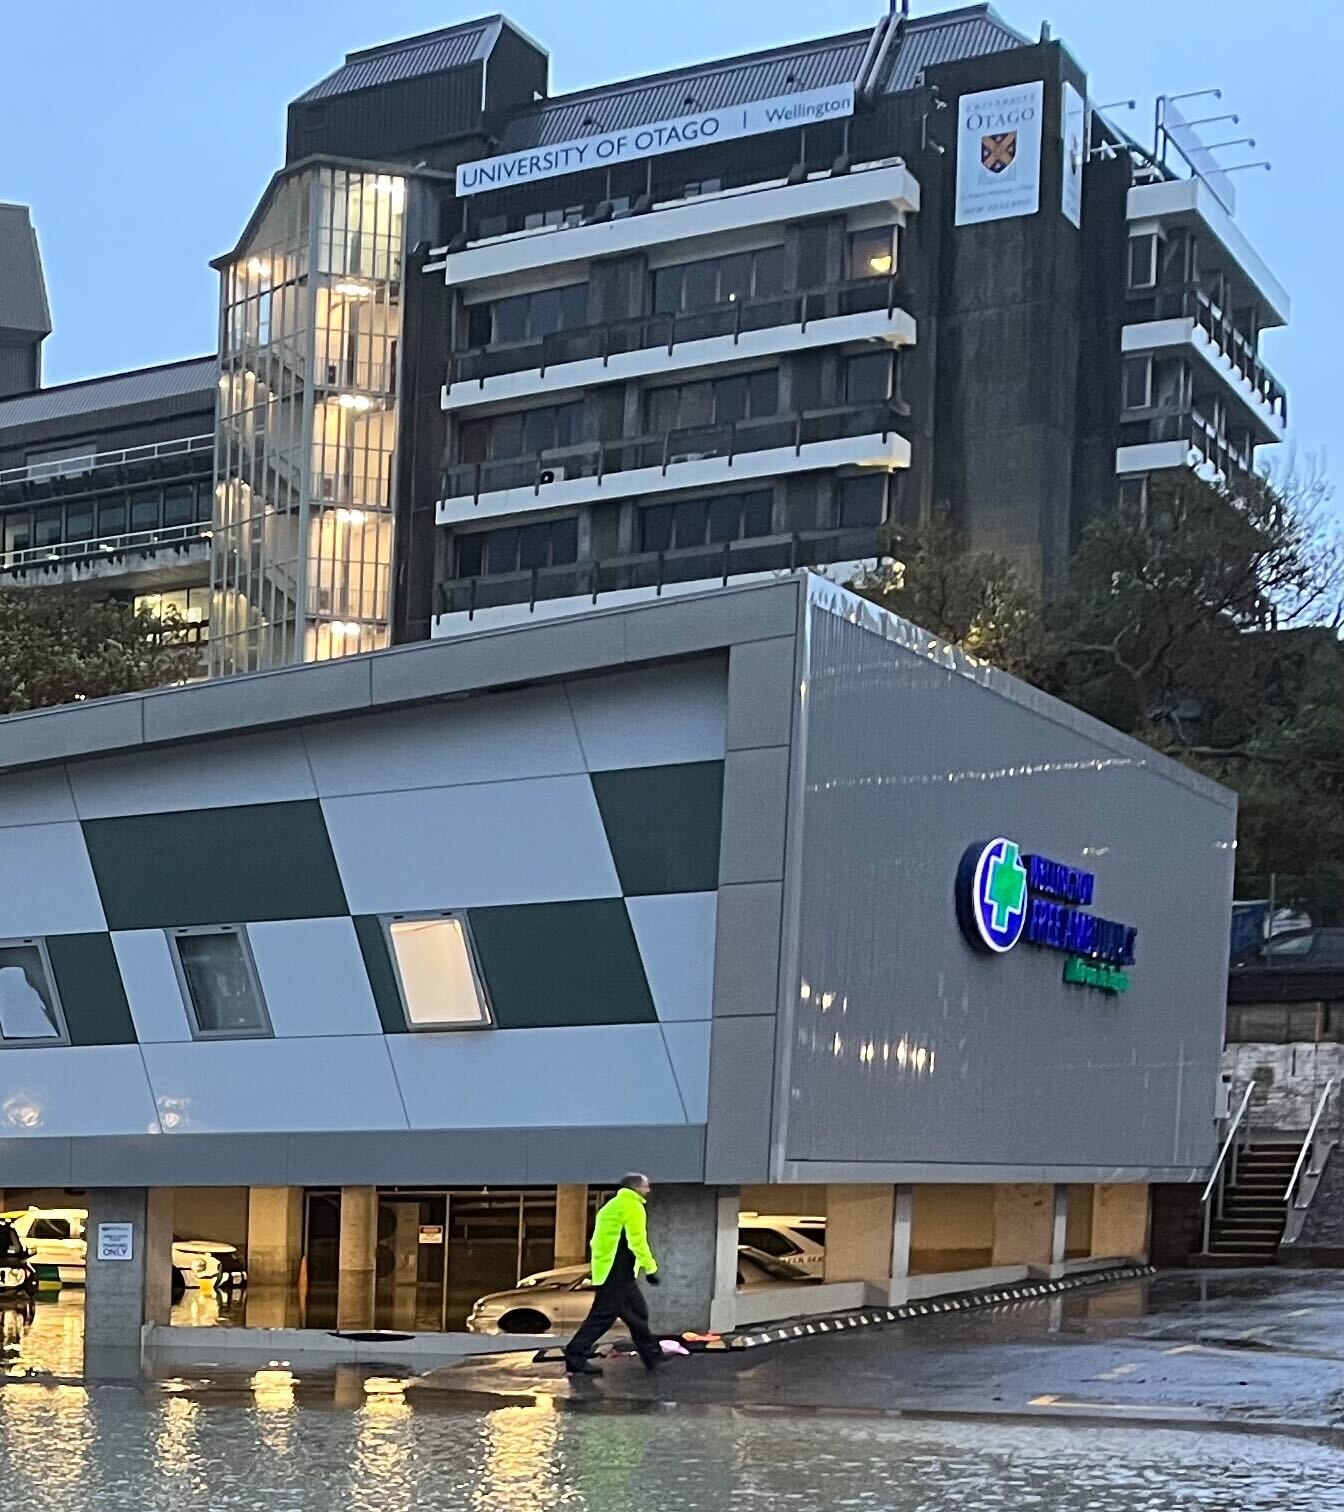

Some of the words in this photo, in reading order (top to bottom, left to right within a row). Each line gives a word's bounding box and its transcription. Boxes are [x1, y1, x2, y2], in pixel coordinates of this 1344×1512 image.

[463, 143, 589, 188] UNIVERSITY
[596, 136, 628, 159] OF
[635, 117, 720, 151] OTAGO
[765, 97, 851, 124] Wellington
[103, 1248, 129, 1257] ONLY
